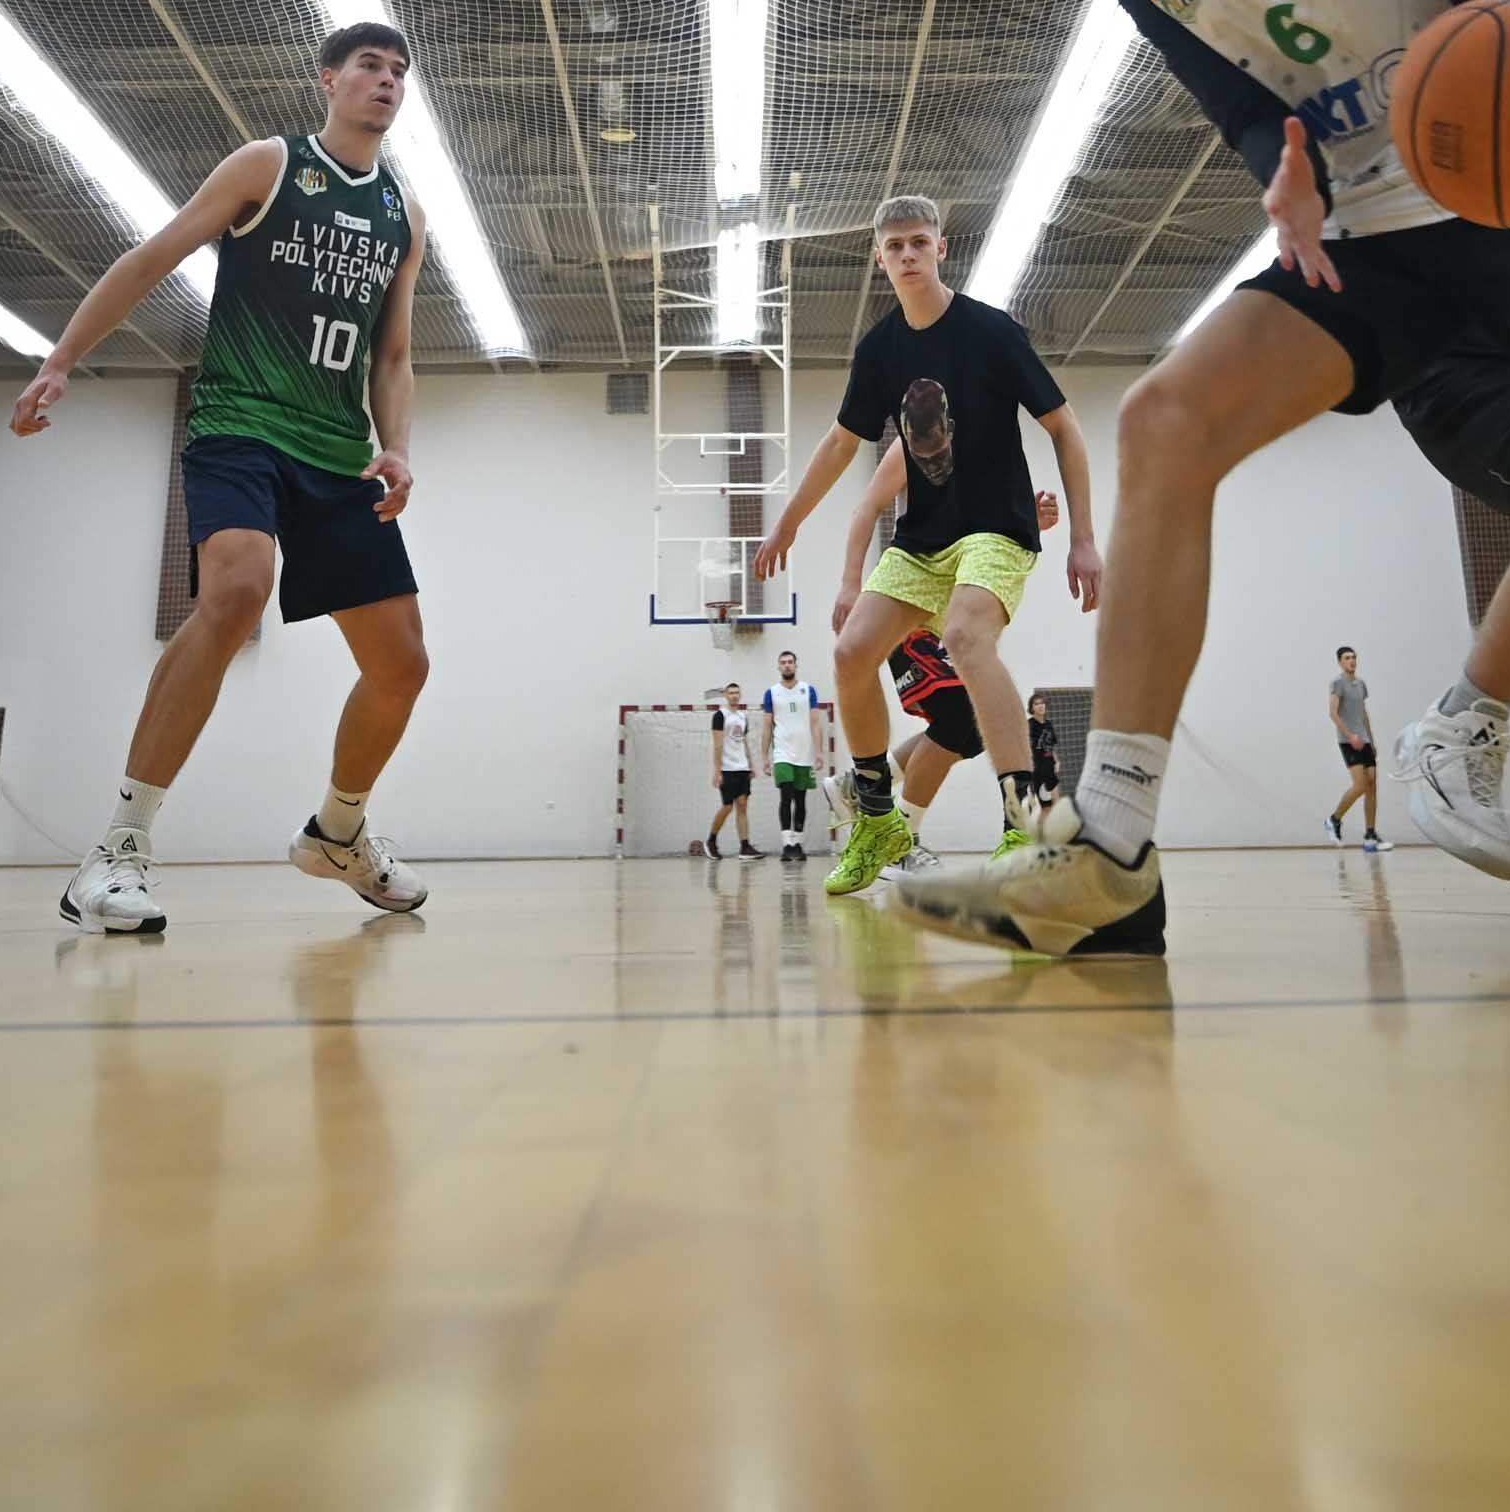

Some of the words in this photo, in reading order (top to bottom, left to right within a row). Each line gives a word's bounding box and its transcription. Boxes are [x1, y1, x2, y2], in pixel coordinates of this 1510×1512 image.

[1265, 3, 1330, 65] 6
[292, 219, 399, 268] LVIVSKA
[311, 271, 372, 304] KIVS
[309, 314, 358, 372] 10
